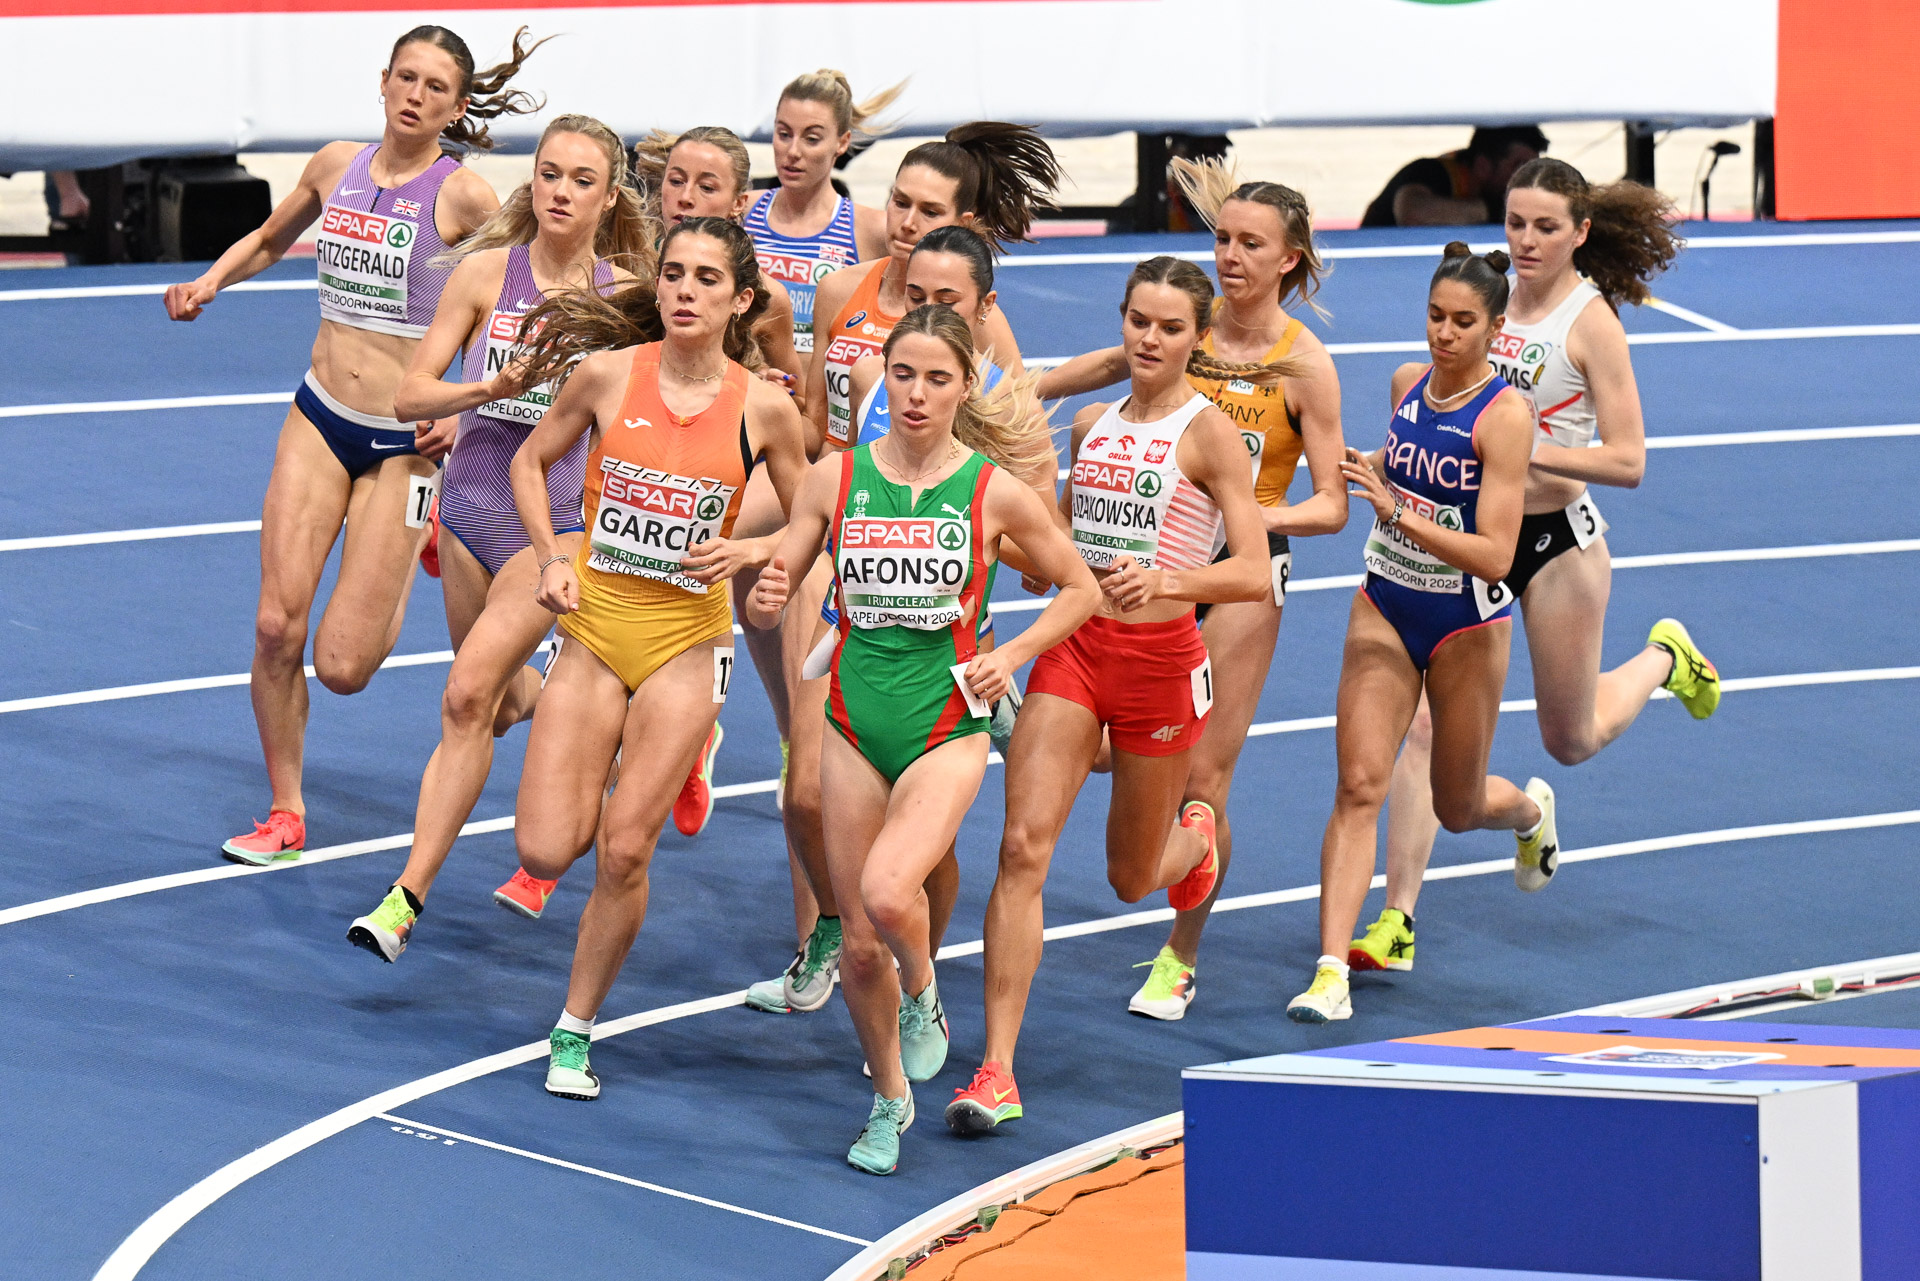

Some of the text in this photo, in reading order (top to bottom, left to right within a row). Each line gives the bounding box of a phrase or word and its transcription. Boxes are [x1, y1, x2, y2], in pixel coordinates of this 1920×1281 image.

[324, 210, 385, 242] SPAR
[317, 238, 405, 280] FITZGERALD
[332, 278, 348, 290] RUN
[319, 287, 404, 315] APELDOORN 2025
[1490, 335, 1522, 357] AR
[1087, 436, 1110, 451] 4F
[1107, 452, 1132, 462] ORLEN
[1384, 430, 1480, 491] RANCE
[1074, 462, 1132, 490] SPAR
[416, 485, 434, 522] 11
[606, 476, 694, 516] SPAR
[599, 506, 712, 552] GARCÍA
[845, 523, 932, 545] SPAR
[1579, 504, 1596, 536] 3
[1080, 532, 1095, 544] RUN
[619, 551, 645, 566] RUN
[842, 556, 963, 586] AFONSO
[1365, 554, 1459, 590] APELDOORN 2025
[872, 595, 895, 607] RUN
[851, 610, 961, 625] APELDOORN 2025
[1150, 724, 1185, 742] 4F
